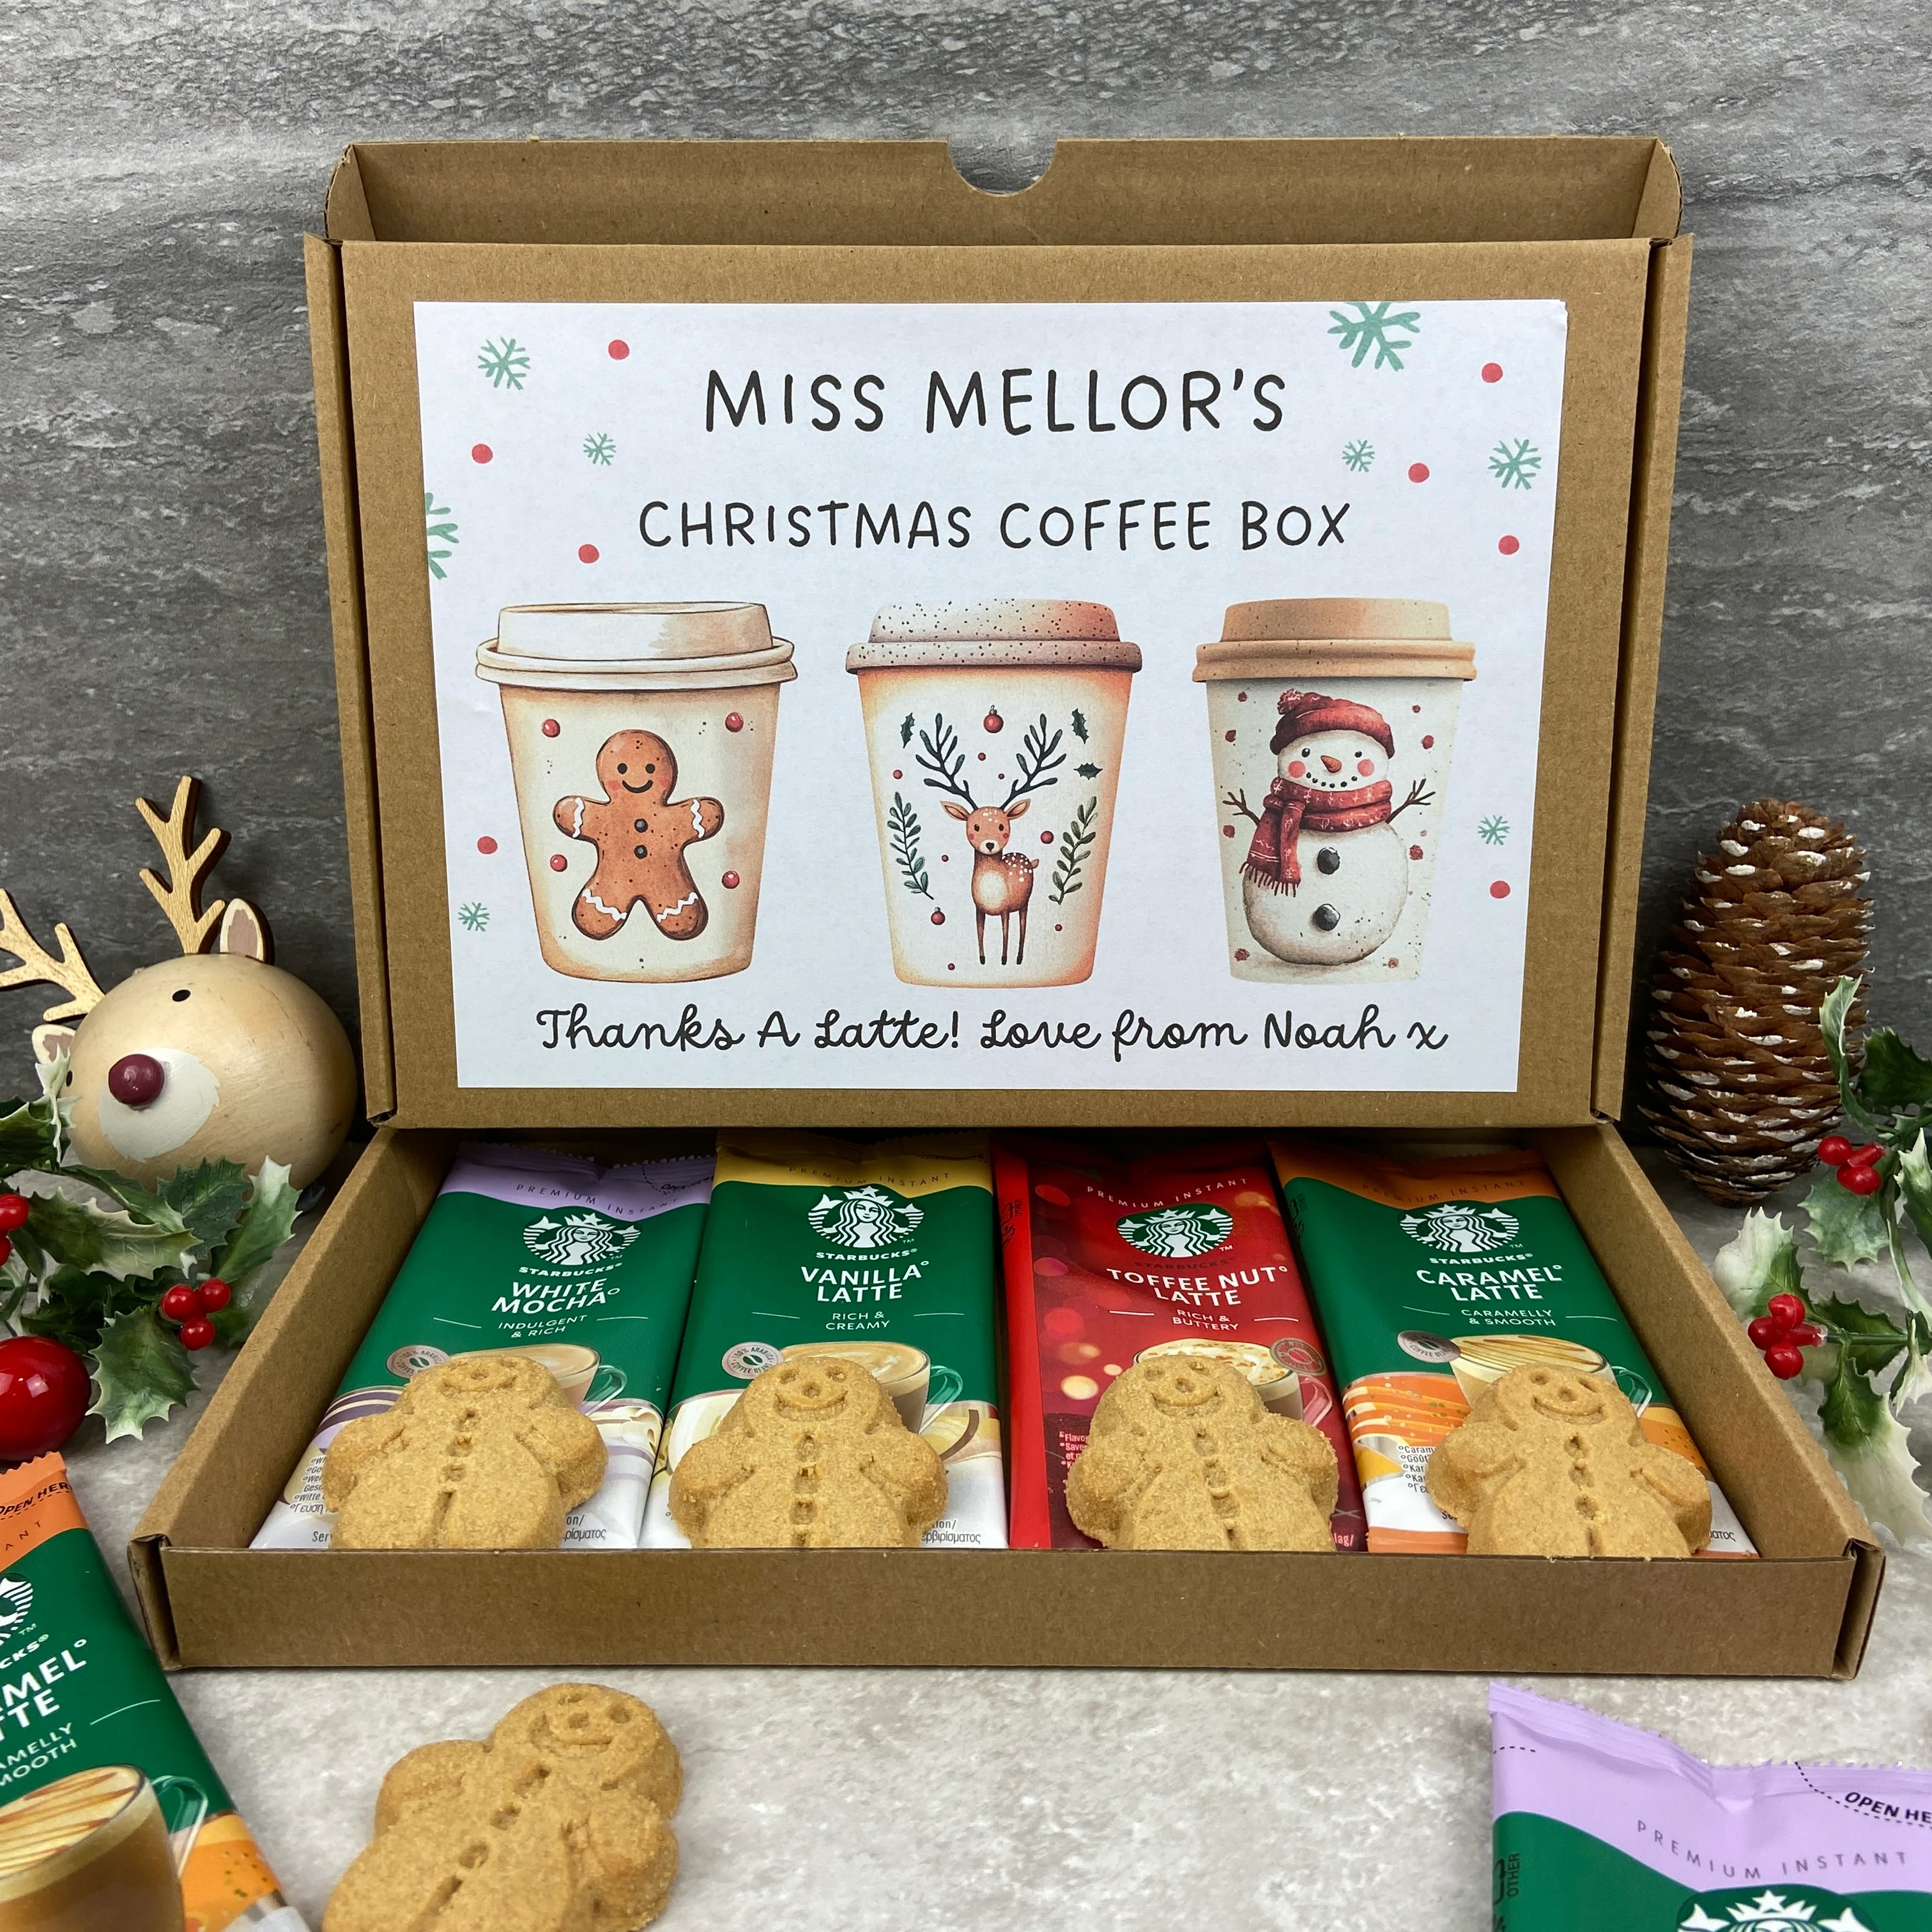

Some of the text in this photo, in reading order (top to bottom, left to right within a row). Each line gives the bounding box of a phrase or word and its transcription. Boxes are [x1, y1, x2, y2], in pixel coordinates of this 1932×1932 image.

[707, 369, 1285, 435] MISS MELLOR'S
[640, 500, 1349, 550] CHRISTMAS COFFEE BOX
[537, 1004, 1448, 1062] Thanks A Latte! Love from Noah x
[789, 1166, 949, 1186] PREMIUM INSTANT
[516, 1183, 596, 1204] PREMIUM
[1087, 1178, 1246, 1208] PREMIUM INSTANT
[1450, 1180, 1524, 1197] INSTANT
[513, 1278, 607, 1298] WHITE
[1106, 1268, 1211, 1291] TOFFEE
[817, 1283, 903, 1303] LATTE
[1154, 1287, 1241, 1307] LATTE
[1450, 1284, 1543, 1301] LATTE
[498, 1315, 588, 1330] INDULGENT
[825, 1320, 890, 1330] CREAMY
[832, 1312, 868, 1321] RICH
[1172, 1317, 1239, 1331] BUTTERY
[1177, 1309, 1213, 1322] RICH
[528, 1326, 566, 1337] RICH
[0, 1738, 77, 1787] MOOTH
[1844, 1791, 1899, 1818] OPEN
[1637, 1820, 1905, 1880] PREMIUM INSTANT
[1507, 1852, 1520, 1897] OTHER
